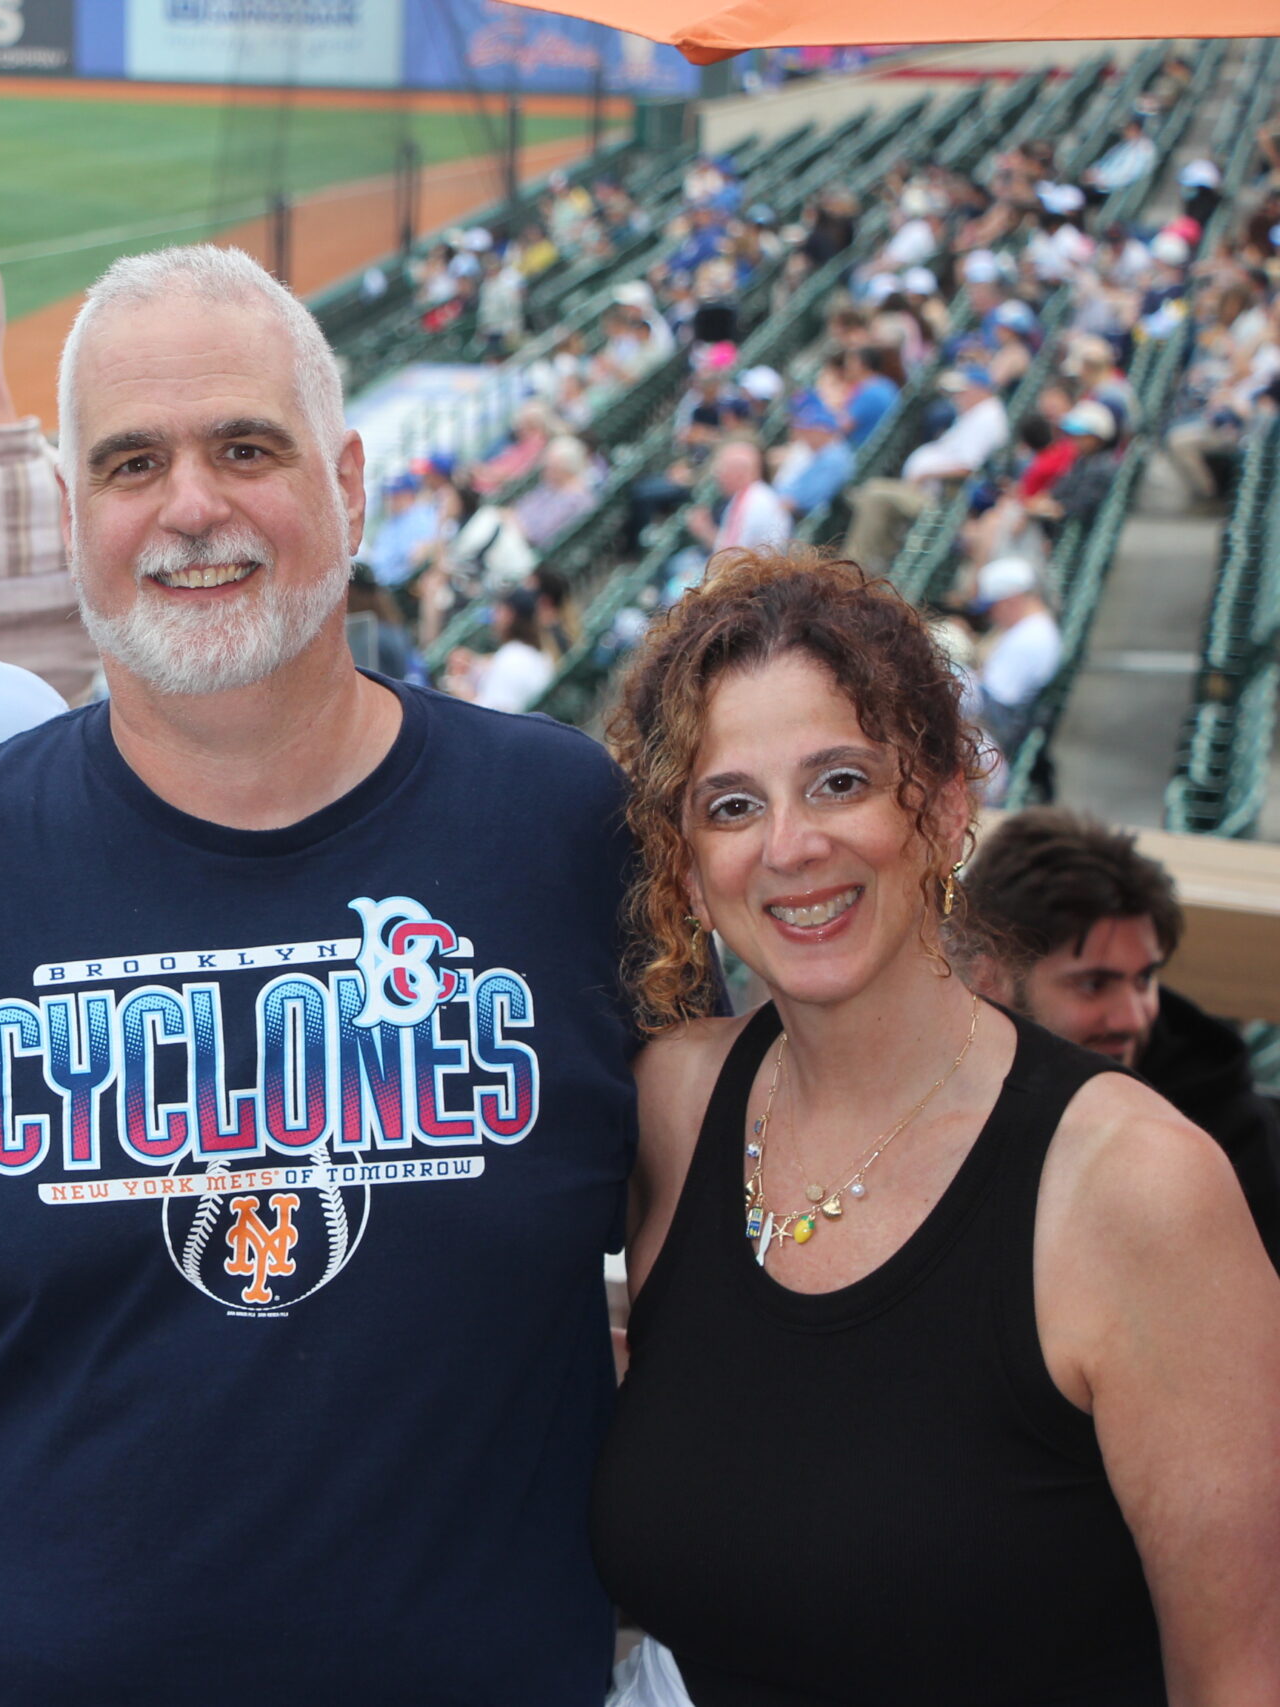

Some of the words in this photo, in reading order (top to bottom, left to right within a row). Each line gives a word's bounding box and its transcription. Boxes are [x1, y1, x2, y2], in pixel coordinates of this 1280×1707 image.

[48, 943, 339, 981] BROOKLYN
[51, 1183, 109, 1201] NEW
[123, 1177, 194, 1196] YORK
[285, 1168, 313, 1185] OF
[326, 1159, 472, 1183] TOMORROW
